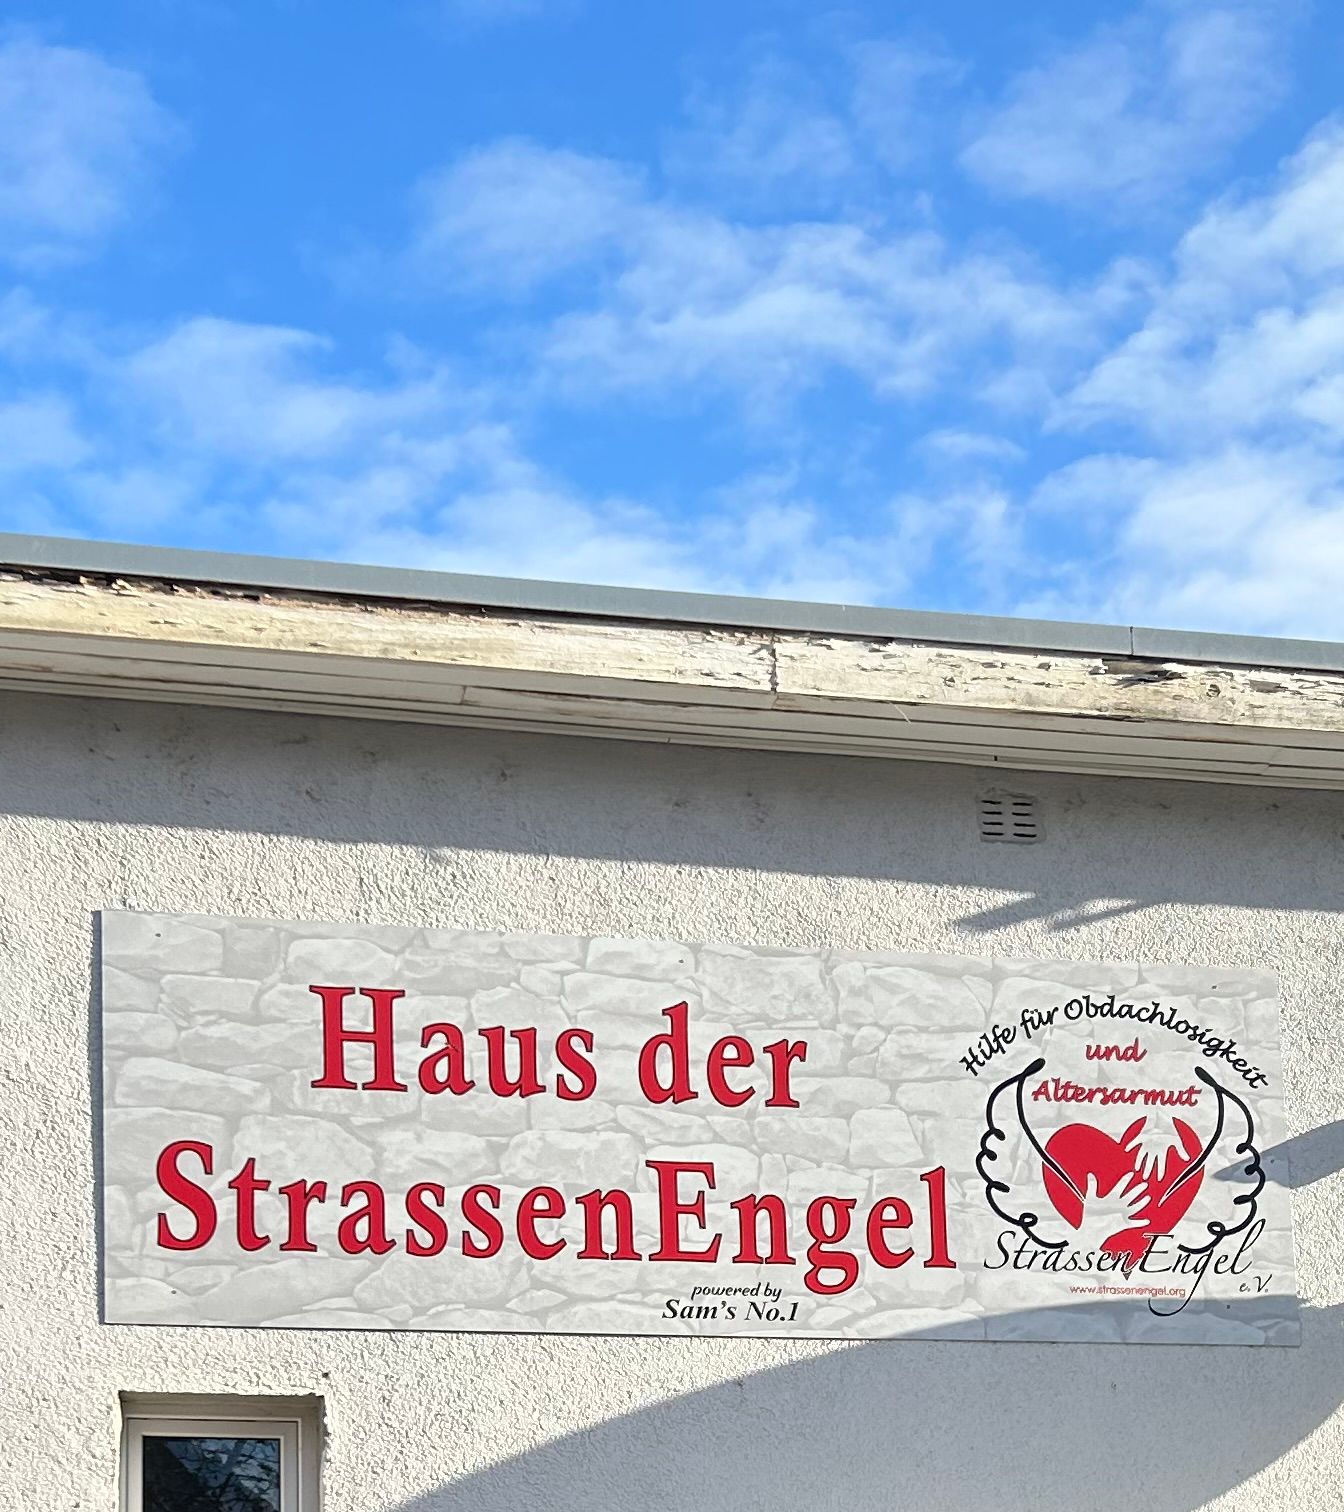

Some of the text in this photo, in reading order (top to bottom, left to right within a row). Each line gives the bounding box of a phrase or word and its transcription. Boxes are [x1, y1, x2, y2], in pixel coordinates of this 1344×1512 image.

[310, 984, 807, 1109] Haus der
[959, 995, 1269, 1090] Hilfe für Obdachlosigkeit
[1085, 1037, 1148, 1062] und
[1031, 1078, 1202, 1106] Altersarmut
[156, 1141, 955, 1295] StrassenEngel
[691, 1281, 783, 1302] powered by
[1069, 1284, 1186, 1298] www.strassenengel.org
[744, 1301, 799, 1321] No.1
